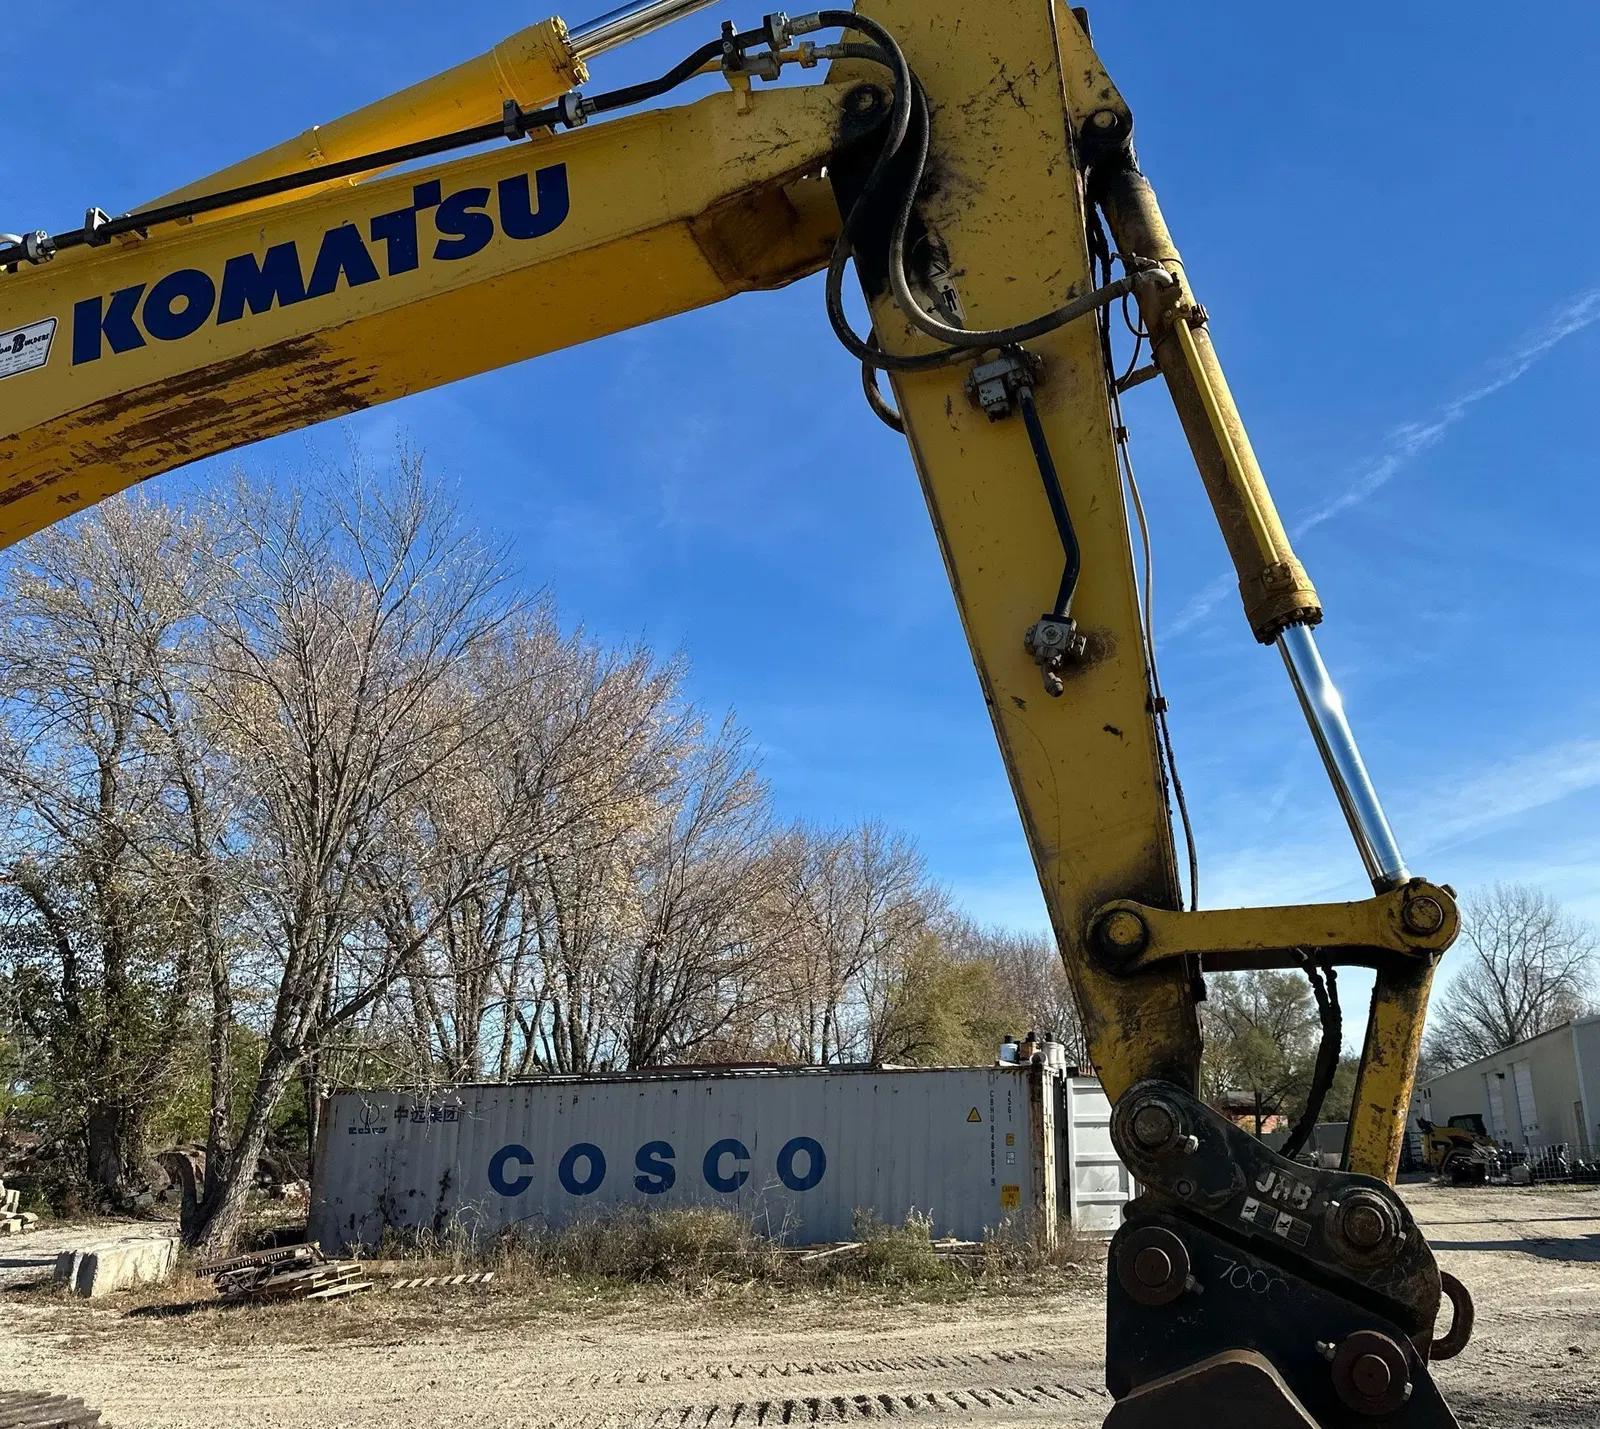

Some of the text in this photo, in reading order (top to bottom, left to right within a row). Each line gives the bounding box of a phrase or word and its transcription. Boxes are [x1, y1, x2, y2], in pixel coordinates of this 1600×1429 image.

[72, 162, 570, 366] KOMATSU
[12, 333, 50, 354] BUILDERS
[394, 1105, 460, 1124] 中远集团
[488, 1136, 827, 1197] COSCO
